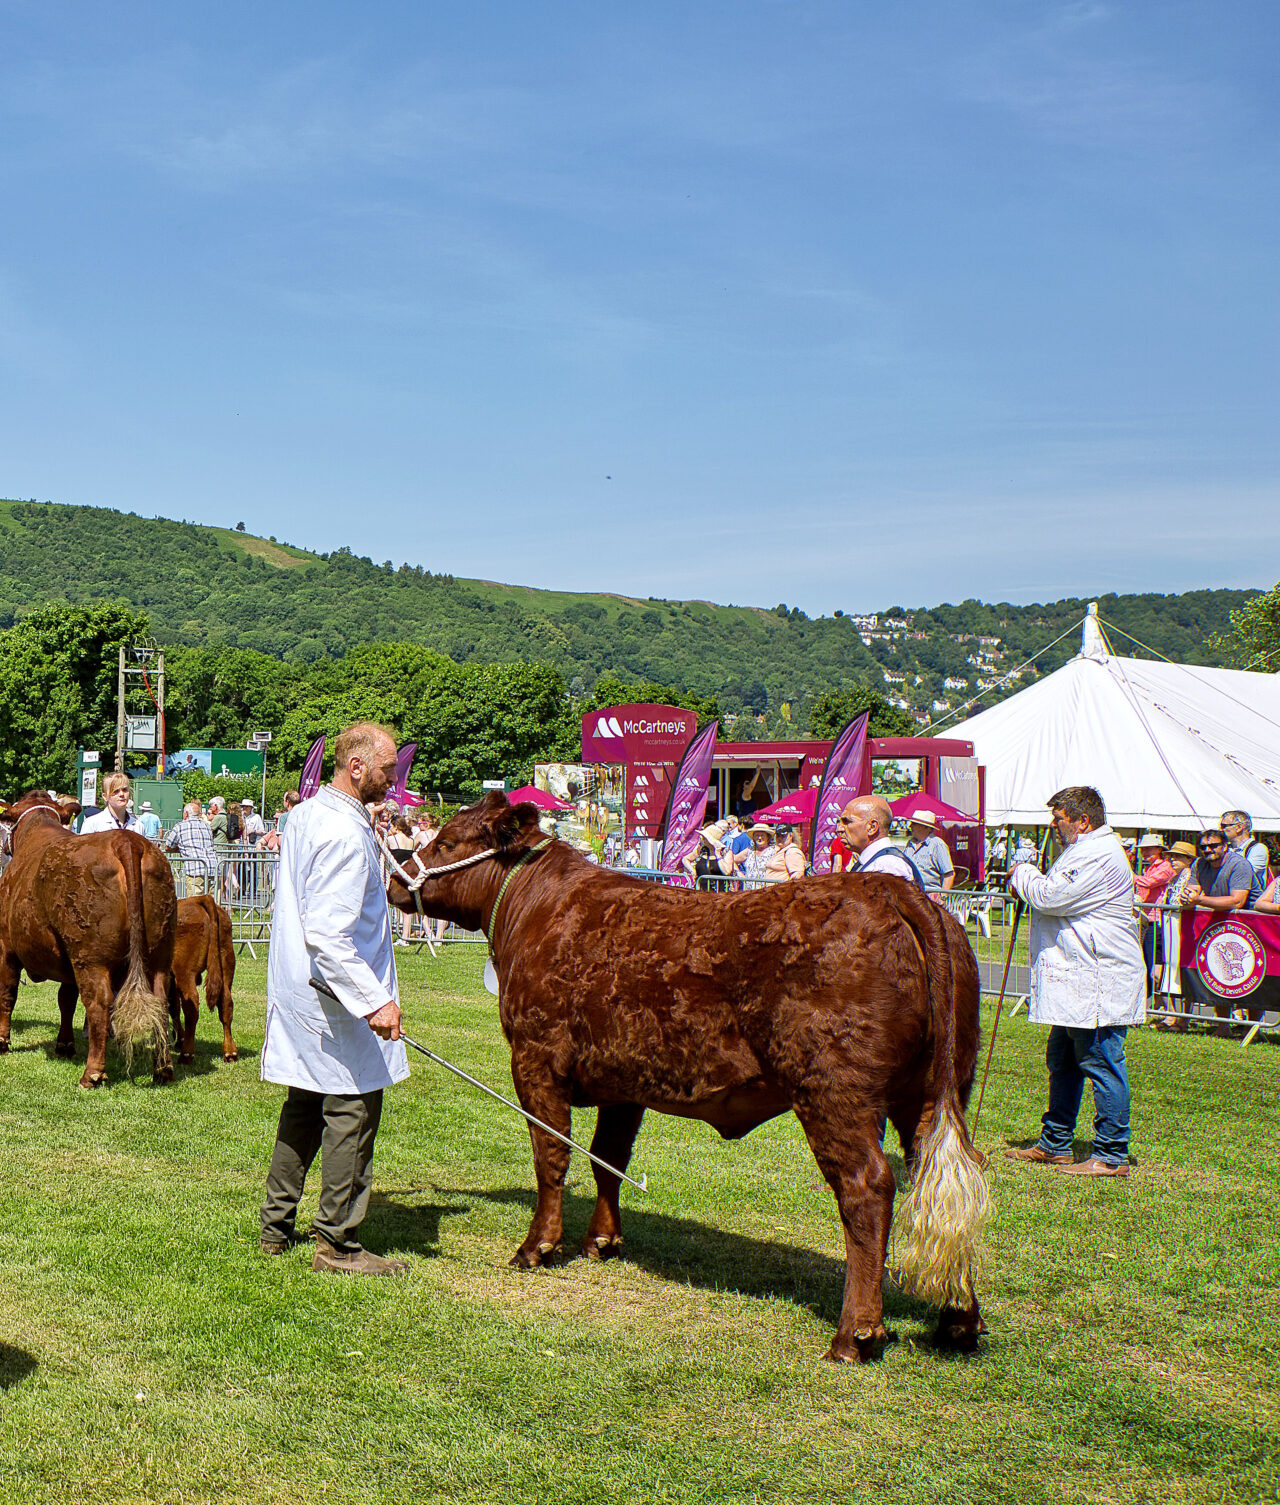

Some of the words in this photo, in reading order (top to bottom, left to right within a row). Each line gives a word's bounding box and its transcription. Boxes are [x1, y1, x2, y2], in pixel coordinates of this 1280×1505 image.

[623, 719, 686, 736] McCartneys
[644, 738, 686, 746] mccartneys.co.uk
[1201, 935, 1211, 948] Red
[1209, 925, 1226, 937] Ruby
[1226, 924, 1247, 936] Devon
[1246, 934, 1261, 953] Cattle
[1203, 971, 1214, 983] Red
[1211, 981, 1226, 994] Ruby
[1225, 987, 1243, 995] Devon
[1242, 975, 1259, 991] Cattle
